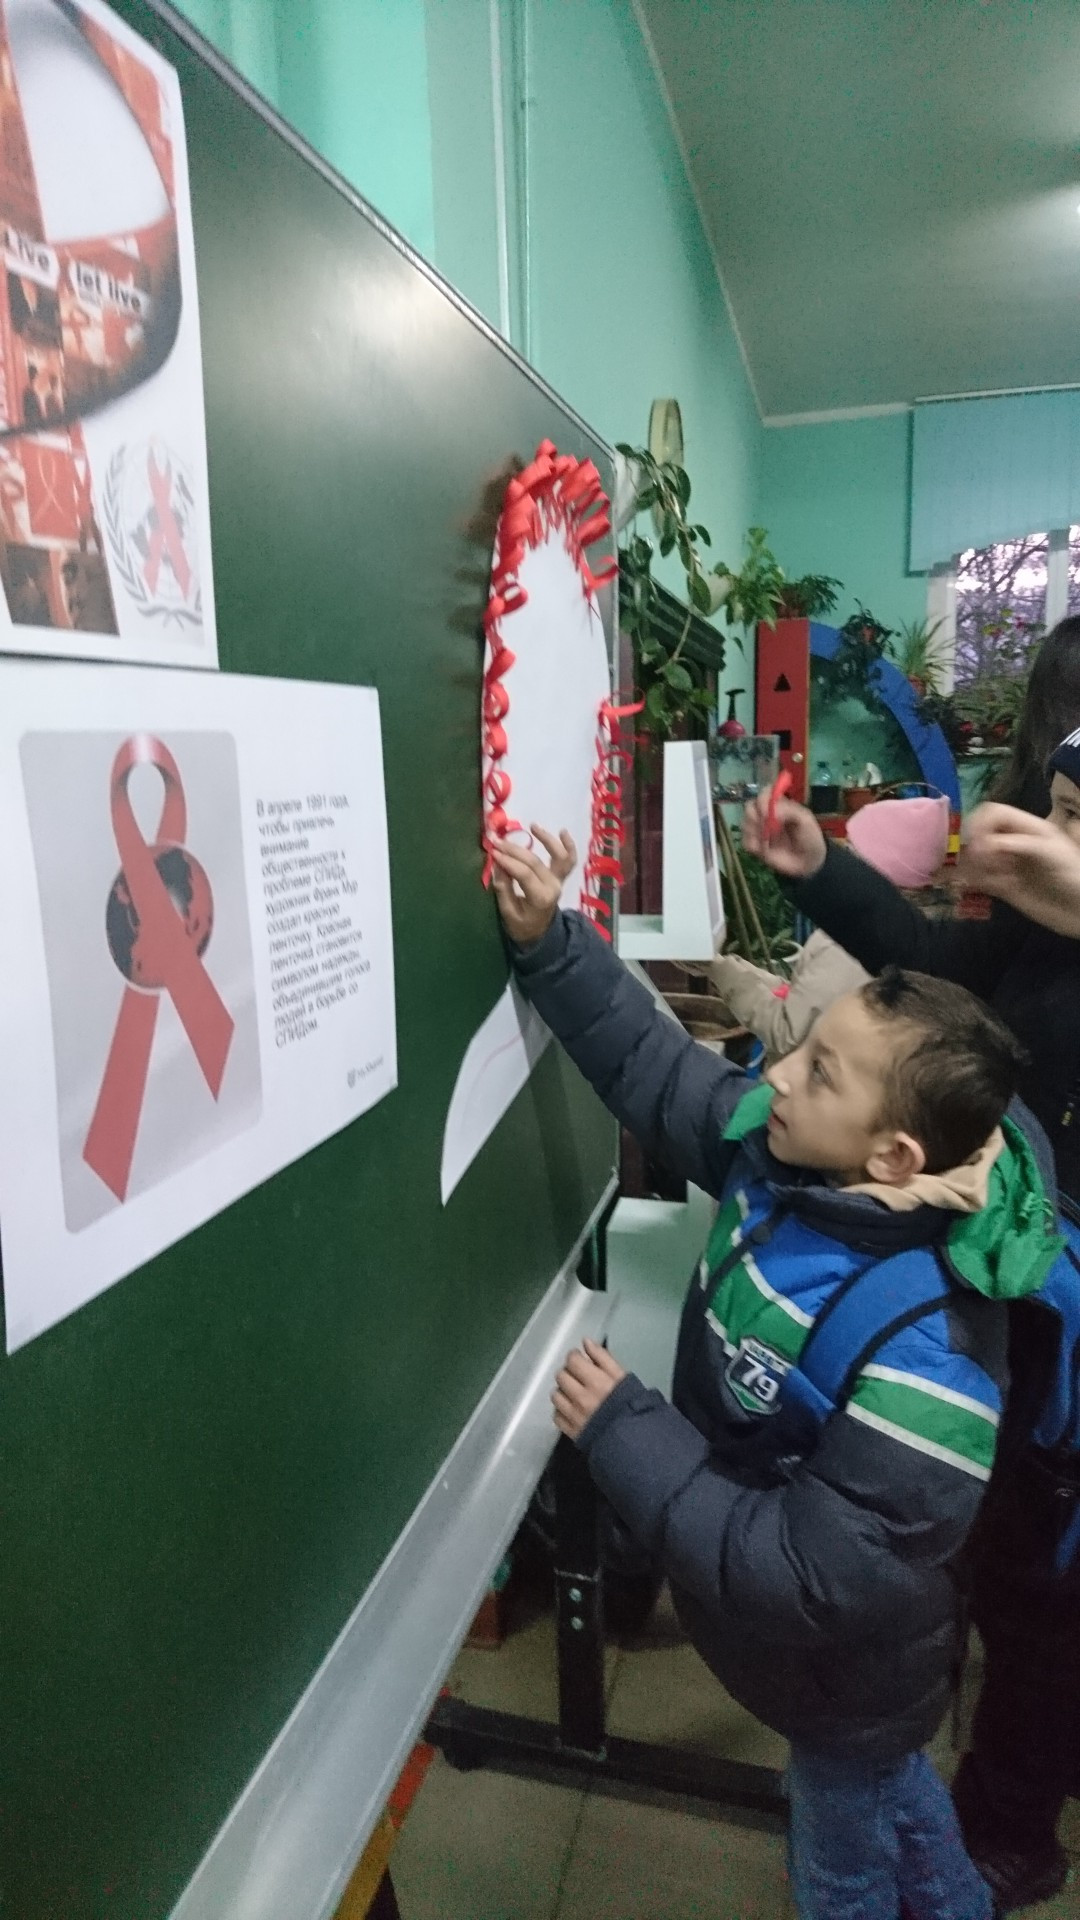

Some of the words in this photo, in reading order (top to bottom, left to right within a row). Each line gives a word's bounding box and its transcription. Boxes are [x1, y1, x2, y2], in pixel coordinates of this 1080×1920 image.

[76, 261, 102, 295] let
[109, 277, 142, 311] live
[256, 798, 264, 817] В
[267, 799, 302, 817] апреле
[306, 794, 326, 811] 1991
[259, 819, 290, 836] чтобы
[293, 816, 335, 834] привлечь
[260, 838, 309, 857] внимание
[263, 873, 311, 898] проблеме
[265, 894, 311, 917] художник
[303, 902, 340, 924] красную
[270, 948, 314, 973] ленточка
[271, 963, 319, 992] символом
[315, 986, 346, 1010] борьбе
[741, 1353, 779, 1402] 79
